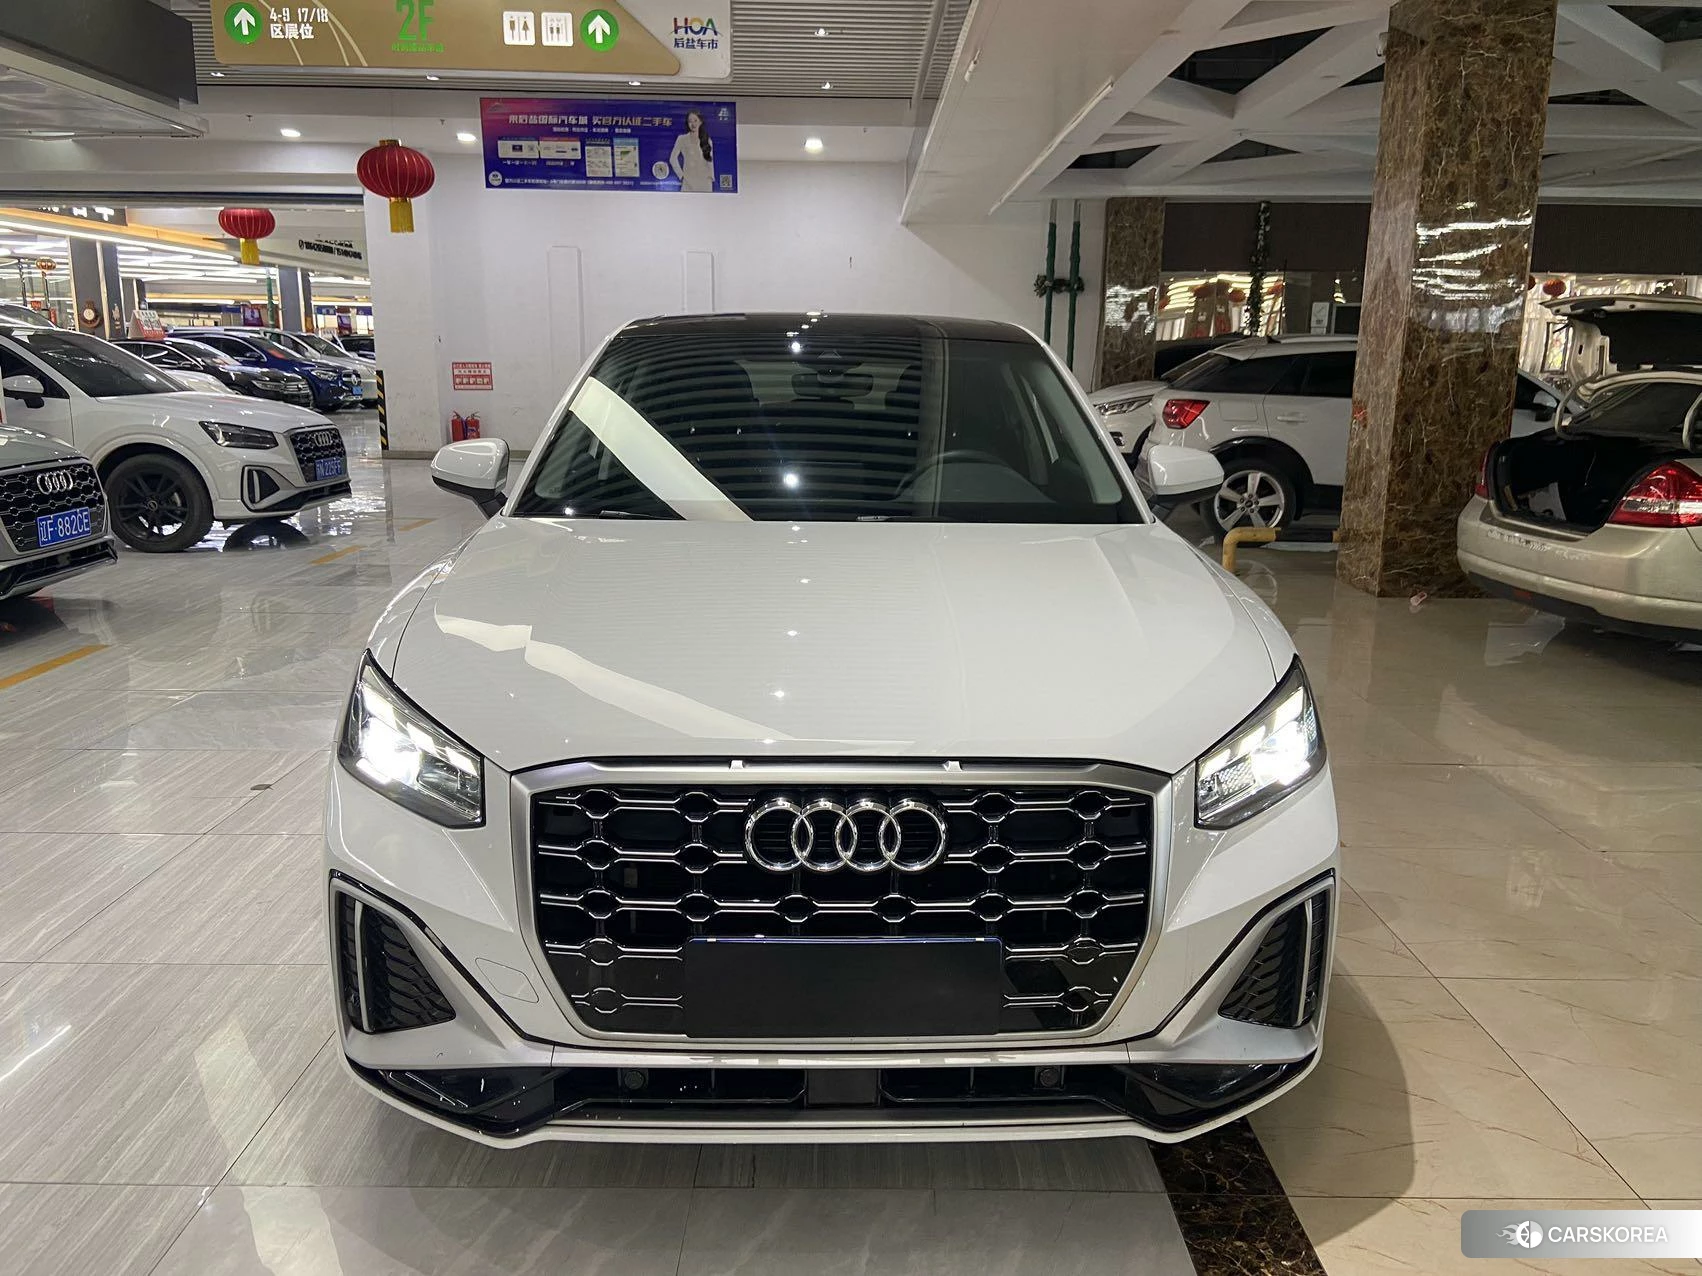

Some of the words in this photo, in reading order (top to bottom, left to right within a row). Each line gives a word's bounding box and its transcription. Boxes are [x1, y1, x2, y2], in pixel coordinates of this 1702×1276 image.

[269, 7, 291, 22] 4-9
[297, 7, 329, 23] 17/18
[396, 0, 435, 42] 2F
[269, 23, 315, 40] 区展位
[673, 16, 718, 36] HOA
[673, 37, 719, 50] 后盐车市
